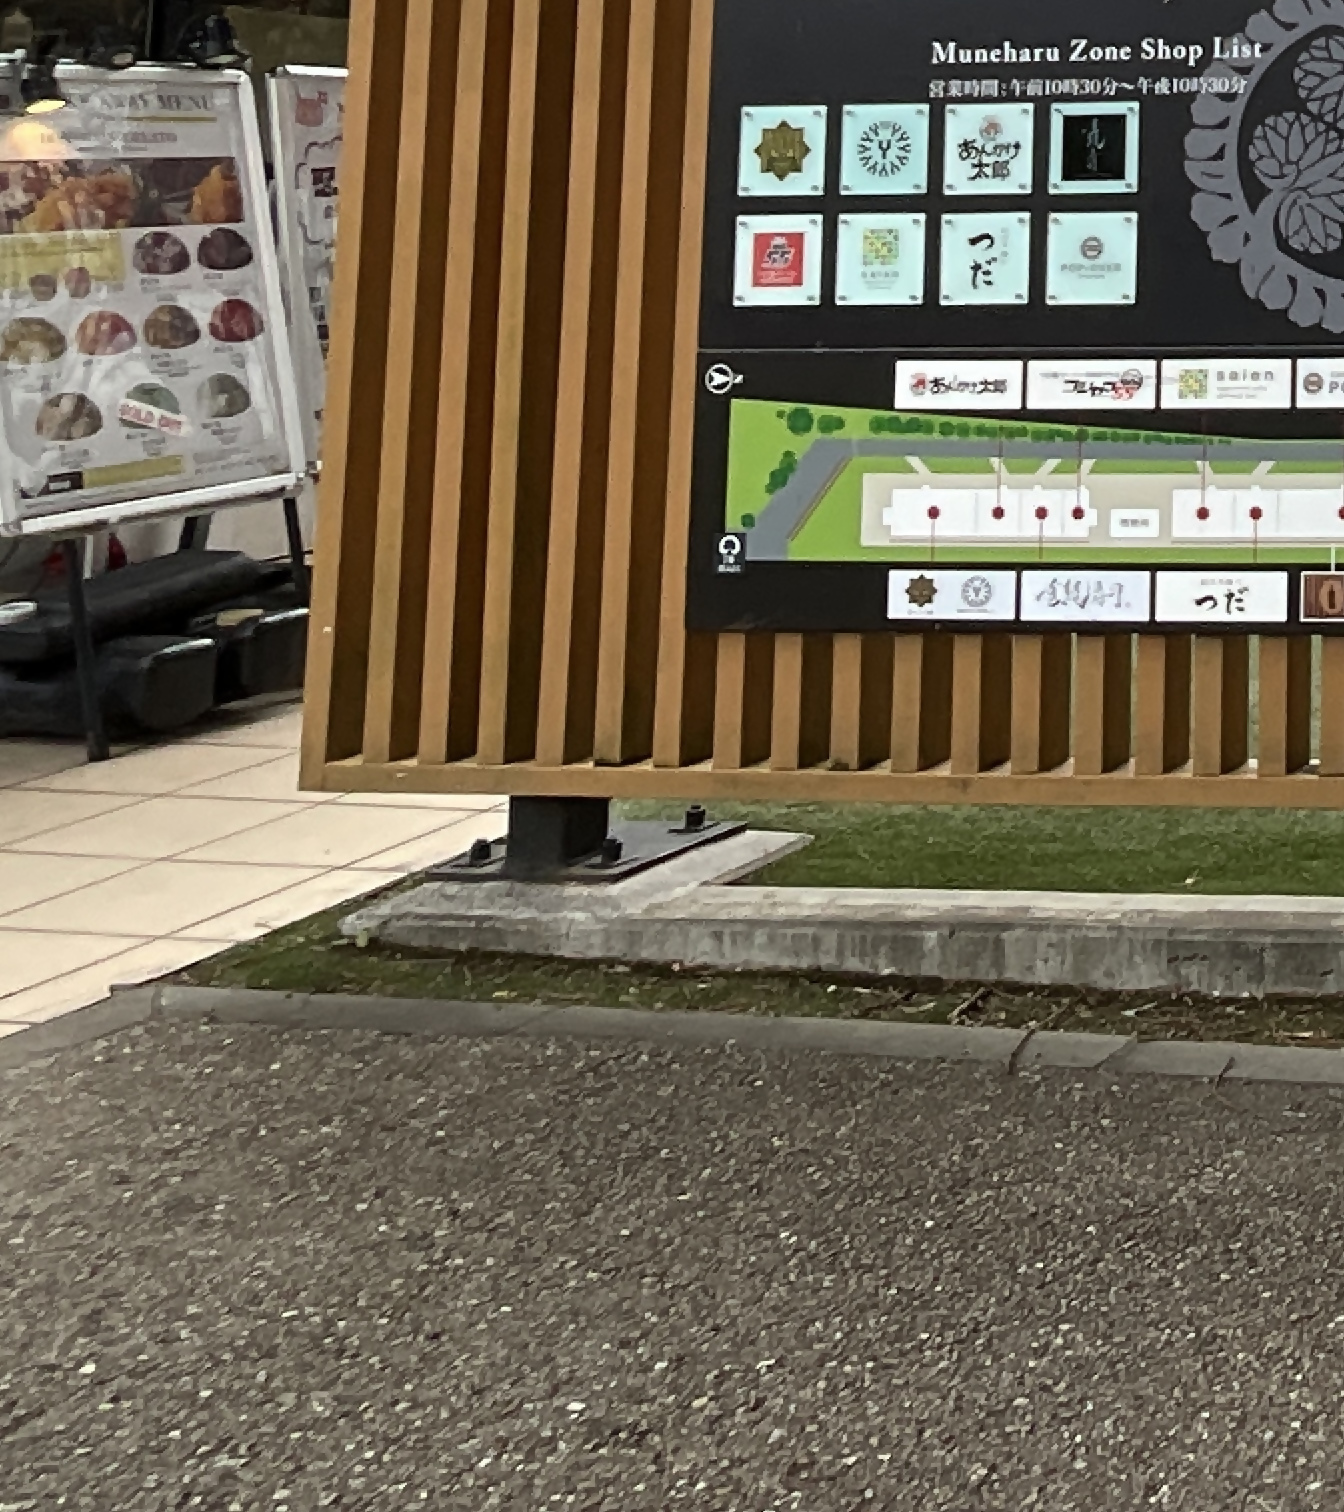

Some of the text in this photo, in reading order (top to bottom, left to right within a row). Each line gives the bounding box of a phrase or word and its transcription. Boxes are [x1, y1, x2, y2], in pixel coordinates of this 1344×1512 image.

[931, 36, 1262, 68] Muneharu Zone Shop List
[967, 233, 998, 289] つだ
[1194, 586, 1249, 615] つだ
